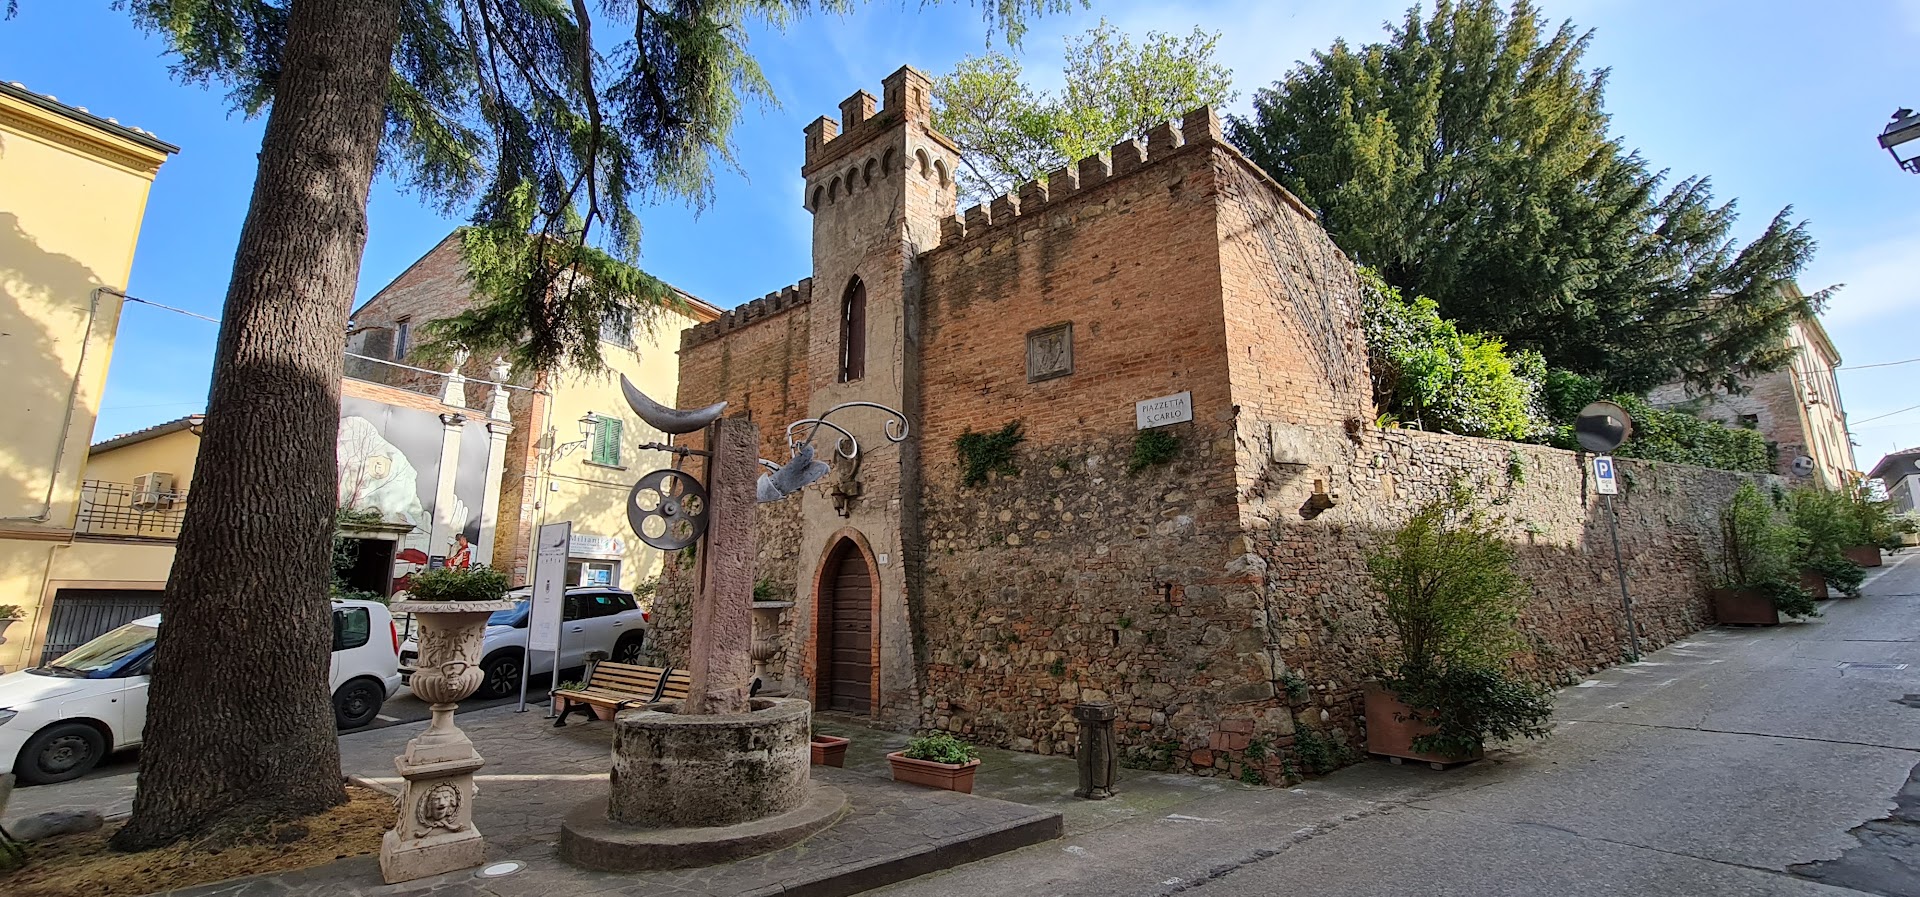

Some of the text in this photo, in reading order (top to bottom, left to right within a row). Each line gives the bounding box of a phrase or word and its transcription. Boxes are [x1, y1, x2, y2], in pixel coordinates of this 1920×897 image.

[1142, 399, 1184, 412] PIAZZETTA
[1154, 410, 1181, 421] CARLO
[1599, 462, 1608, 476] P
